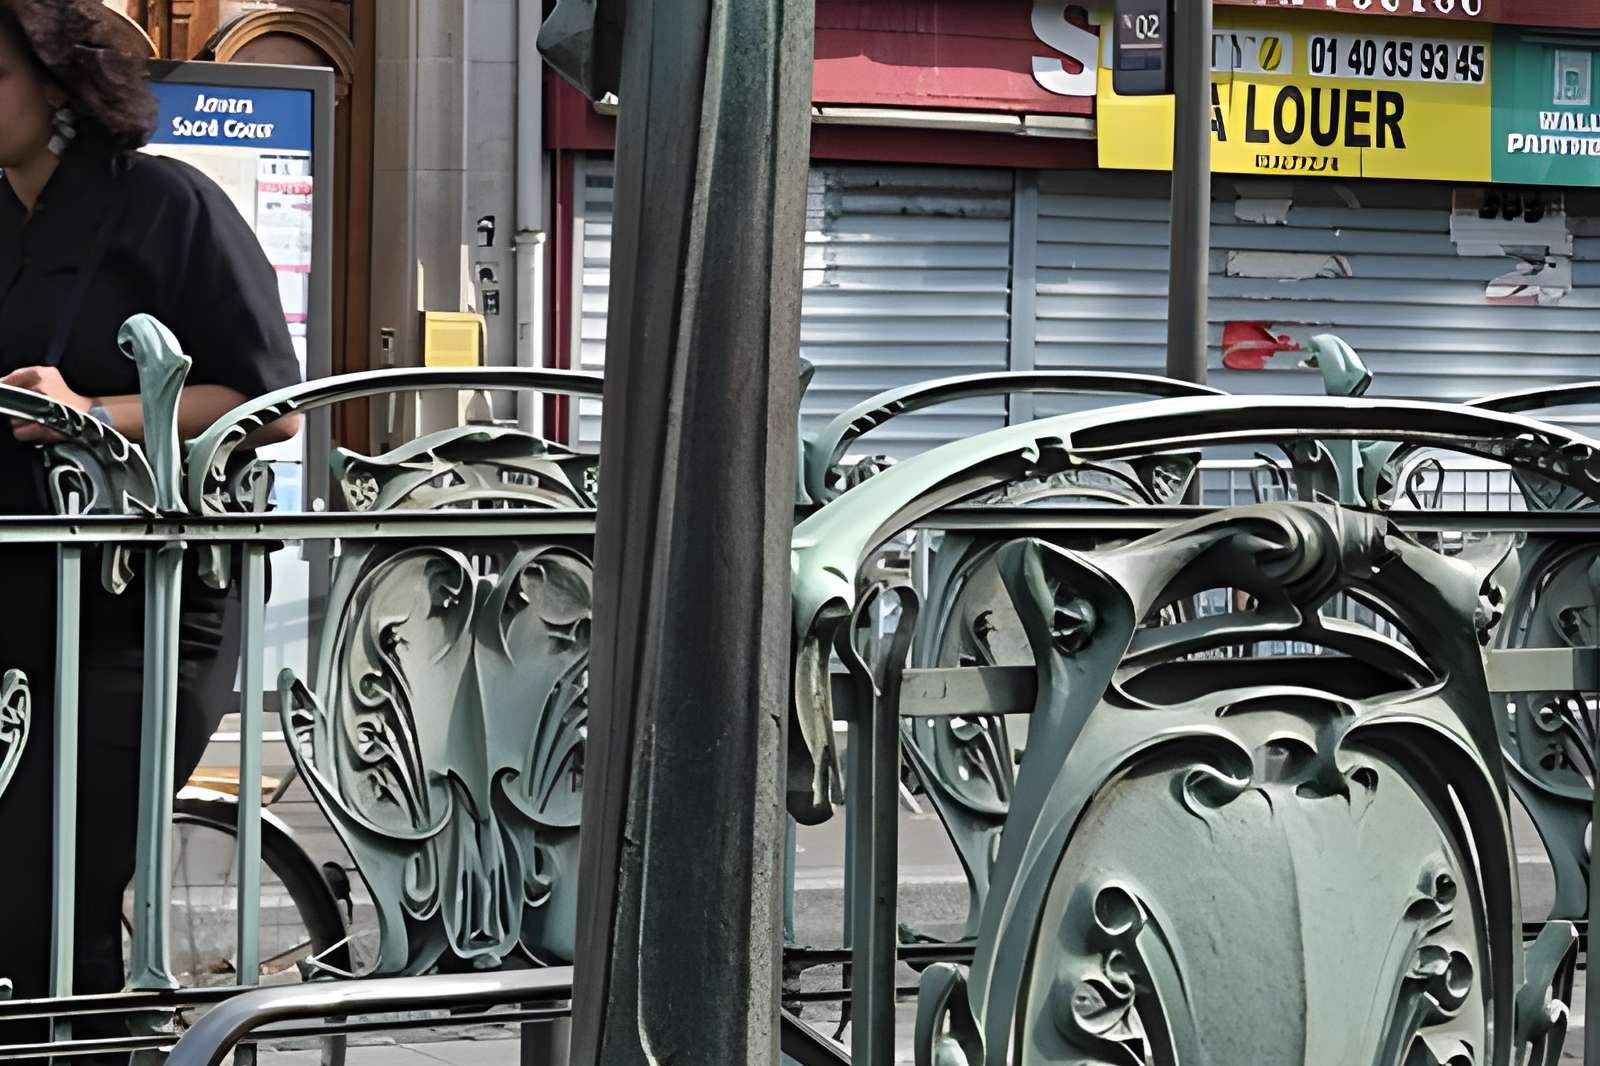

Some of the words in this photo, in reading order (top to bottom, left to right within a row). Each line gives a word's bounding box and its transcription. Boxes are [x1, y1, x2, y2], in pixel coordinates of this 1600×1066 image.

[1311, 37, 1337, 75] 01
[1347, 39, 1377, 75] 40
[1245, 84, 1406, 149] LOUER
